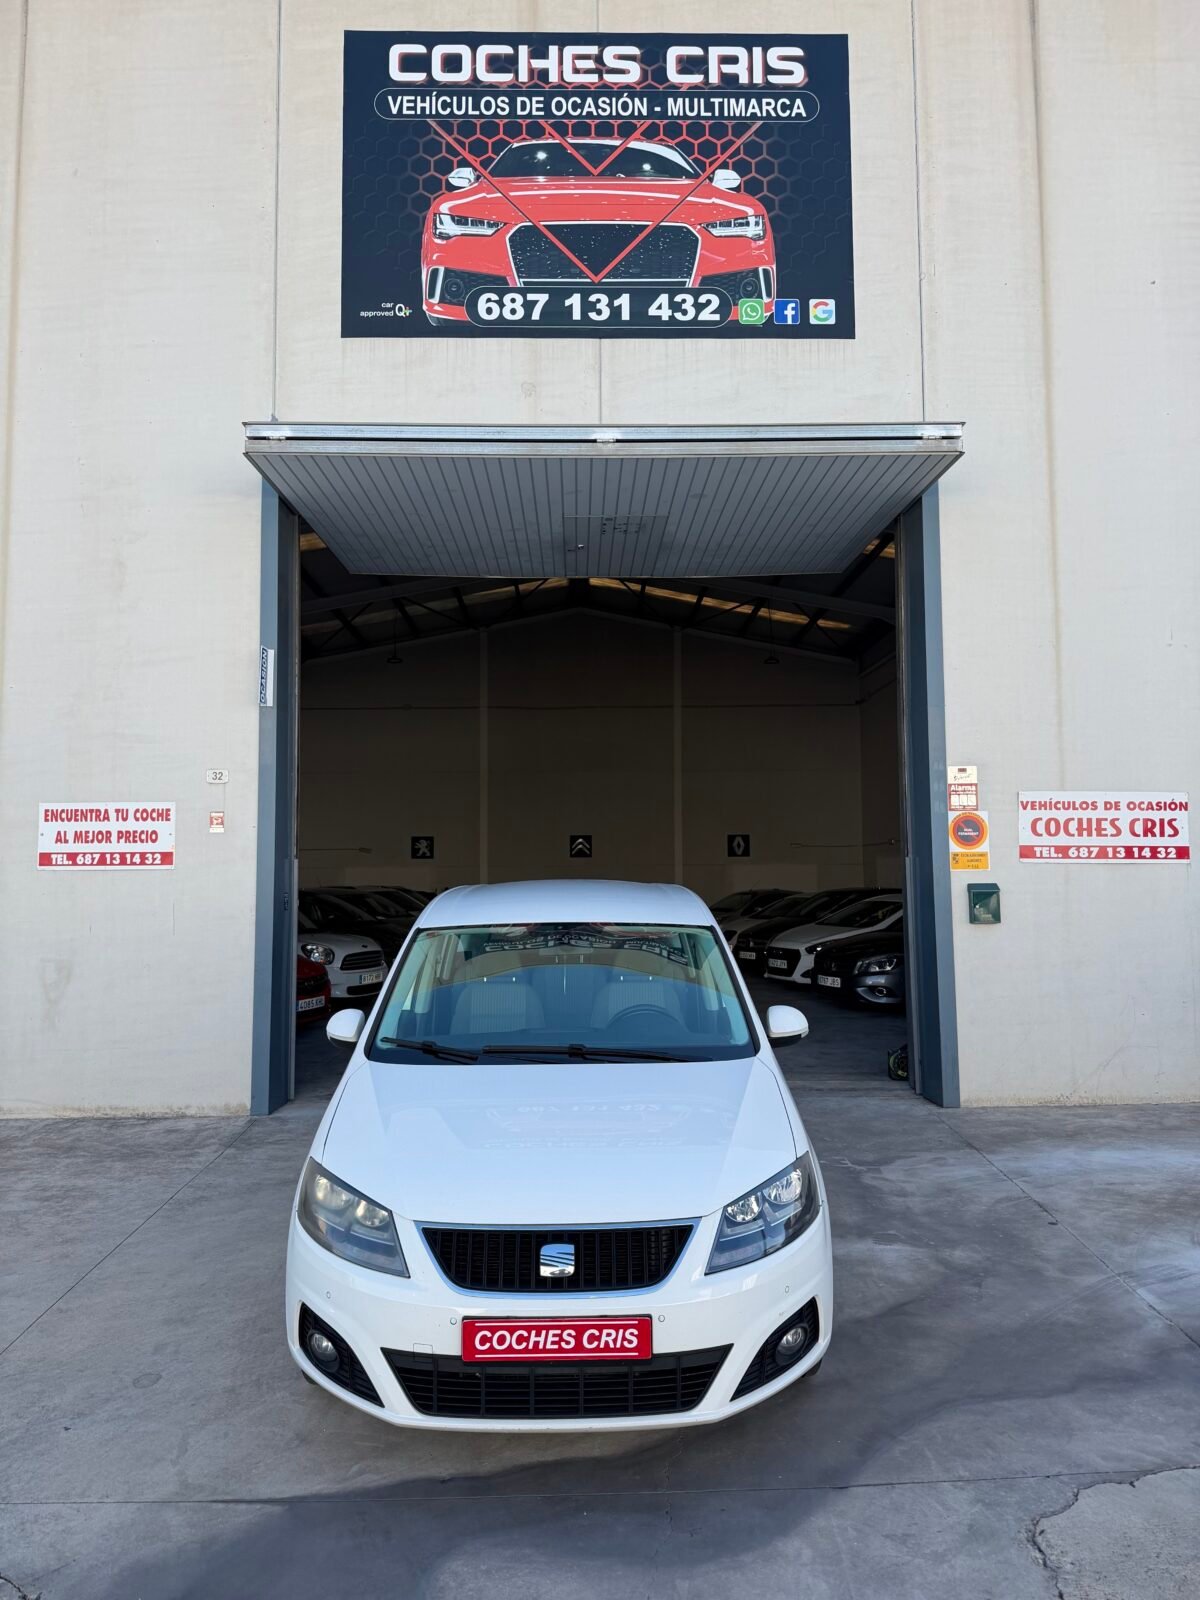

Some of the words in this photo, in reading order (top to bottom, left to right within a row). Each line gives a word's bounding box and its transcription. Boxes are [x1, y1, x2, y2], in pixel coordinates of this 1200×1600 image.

[389, 44, 641, 83] COCHES
[666, 45, 806, 84] CRIS
[387, 91, 510, 115] VEHÍCULOS
[516, 96, 545, 116] DE
[551, 92, 648, 116] OCASIÓN
[667, 97, 807, 117] MULTIMARCA
[360, 309, 394, 317] approved
[477, 292, 549, 321] 687
[564, 293, 631, 321] 131
[648, 293, 721, 321] 432
[211, 771, 223, 781] 32
[1020, 798, 1098, 811] VEHÍCULOS
[1103, 801, 1121, 811] DE
[1126, 798, 1188, 812] OCASIÓN
[43, 808, 110, 822] ENCUENTRA
[114, 808, 129, 822] TU
[133, 808, 171, 822] COCHE
[1030, 817, 1122, 837] COCHES
[1129, 817, 1180, 838] CRIS
[54, 830, 69, 844] AL
[73, 830, 112, 844] MEJOR
[117, 830, 159, 844] PRECIO
[50, 854, 72, 865] TEL.
[76, 853, 101, 865] 687
[105, 854, 121, 864] 13
[125, 854, 140, 864] 14
[145, 853, 162, 864] 32
[1034, 847, 1062, 858] TEL.
[1068, 847, 1100, 858] 687
[1106, 847, 1126, 858] 13
[1132, 847, 1151, 859] 14
[1157, 847, 1177, 859] 32
[474, 1329, 577, 1350] COCHES
[582, 1328, 639, 1350] CRIS
